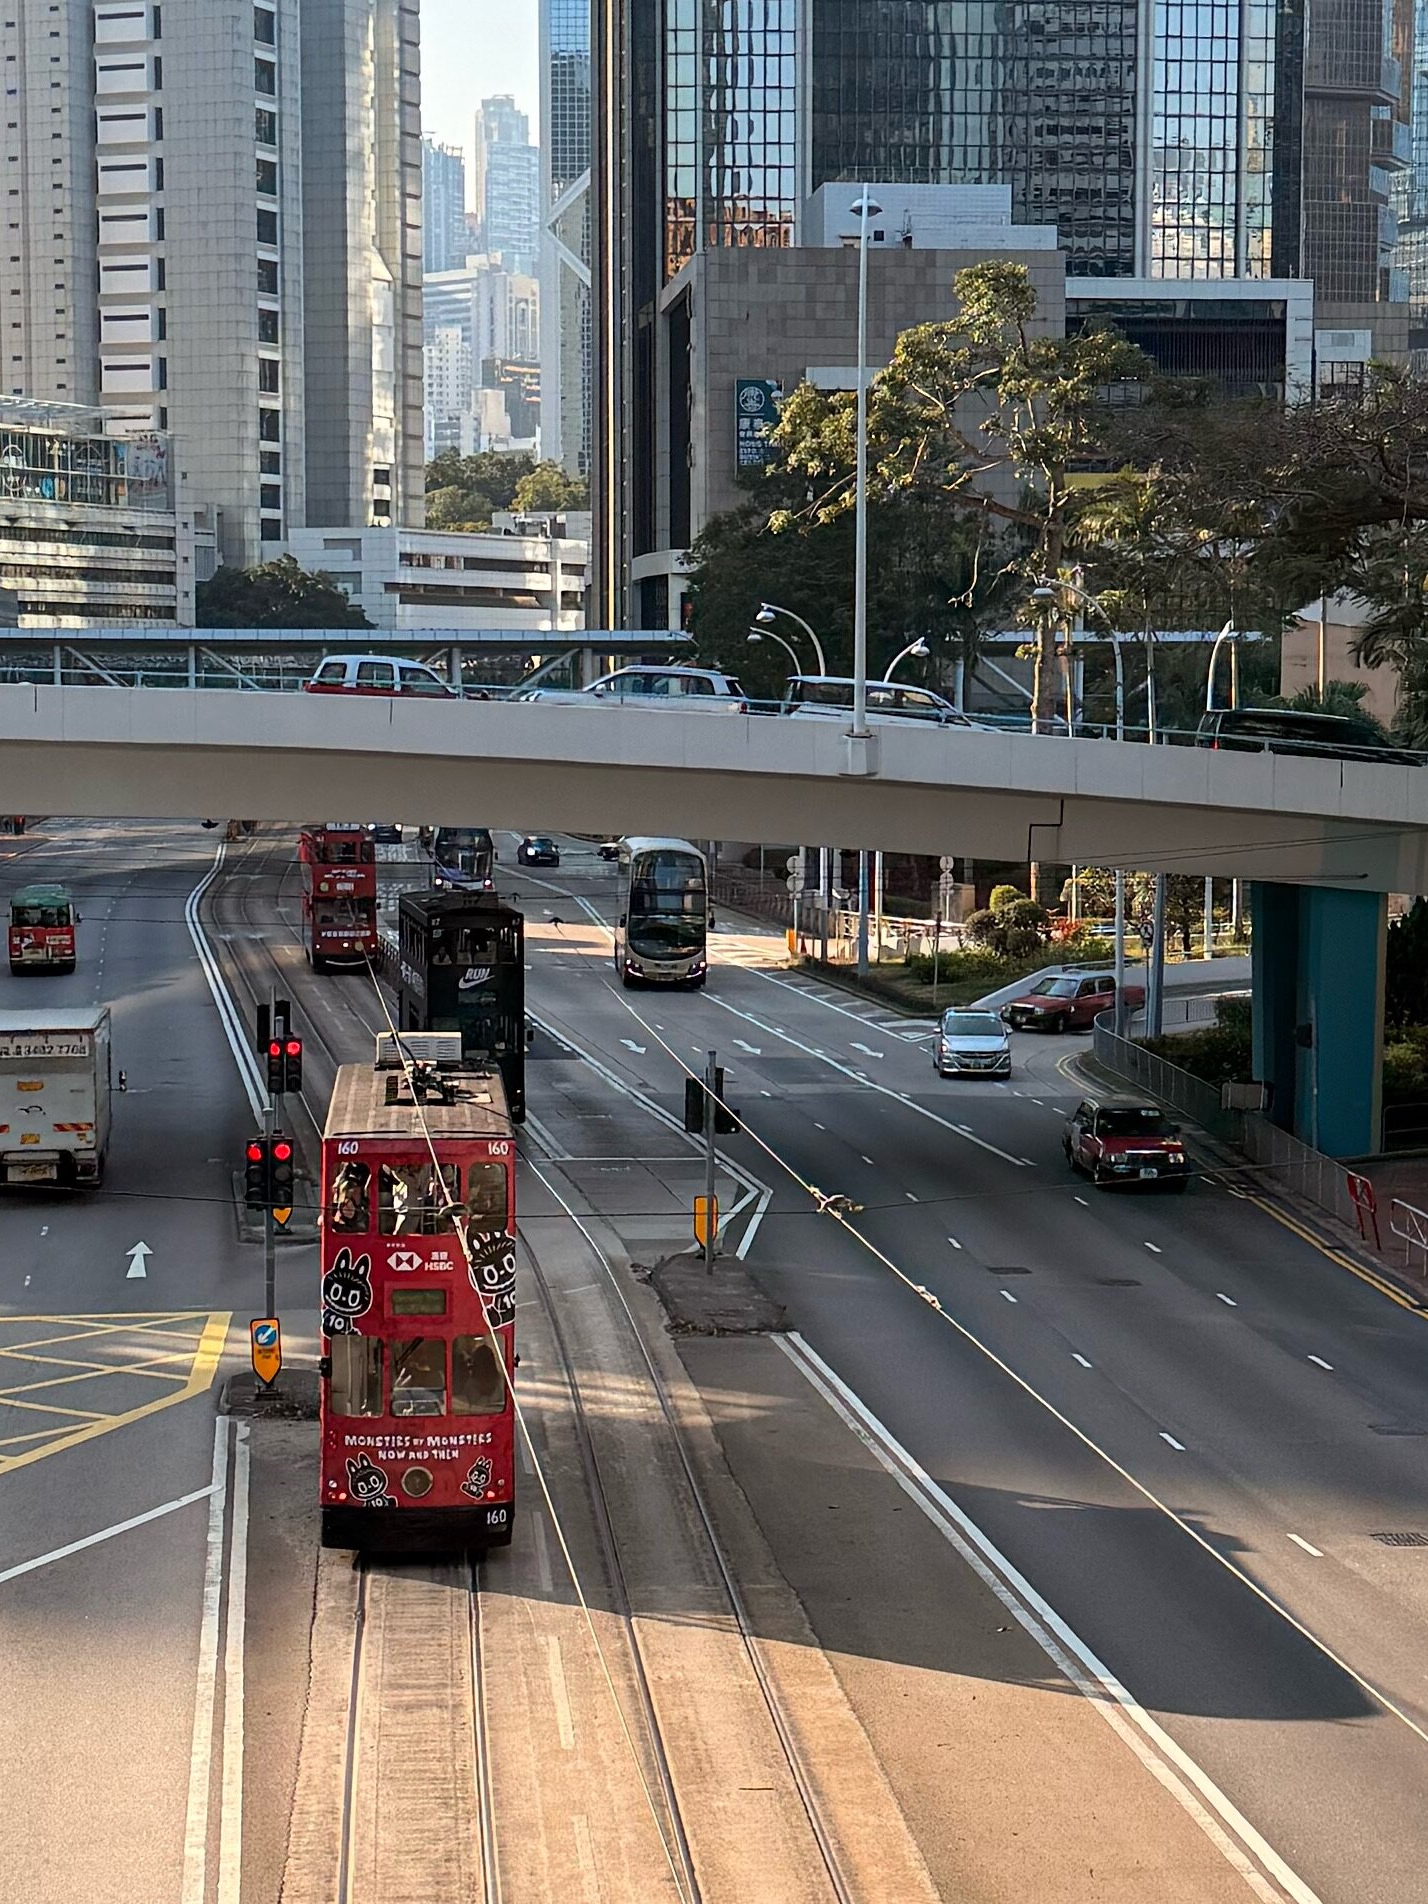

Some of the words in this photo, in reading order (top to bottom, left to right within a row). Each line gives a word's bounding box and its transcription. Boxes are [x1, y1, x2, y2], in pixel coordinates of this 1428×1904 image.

[465, 968, 490, 980] RUN
[338, 1141, 358, 1154] 160
[488, 1142, 508, 1155] 160
[424, 1262, 454, 1271] HSBC
[344, 1435, 411, 1447] MONSTERS
[426, 1432, 492, 1446] MONSTERS
[378, 1450, 405, 1460] NOW
[408, 1450, 428, 1460] AND
[432, 1449, 459, 1459] THEN
[487, 1509, 507, 1525] 160
